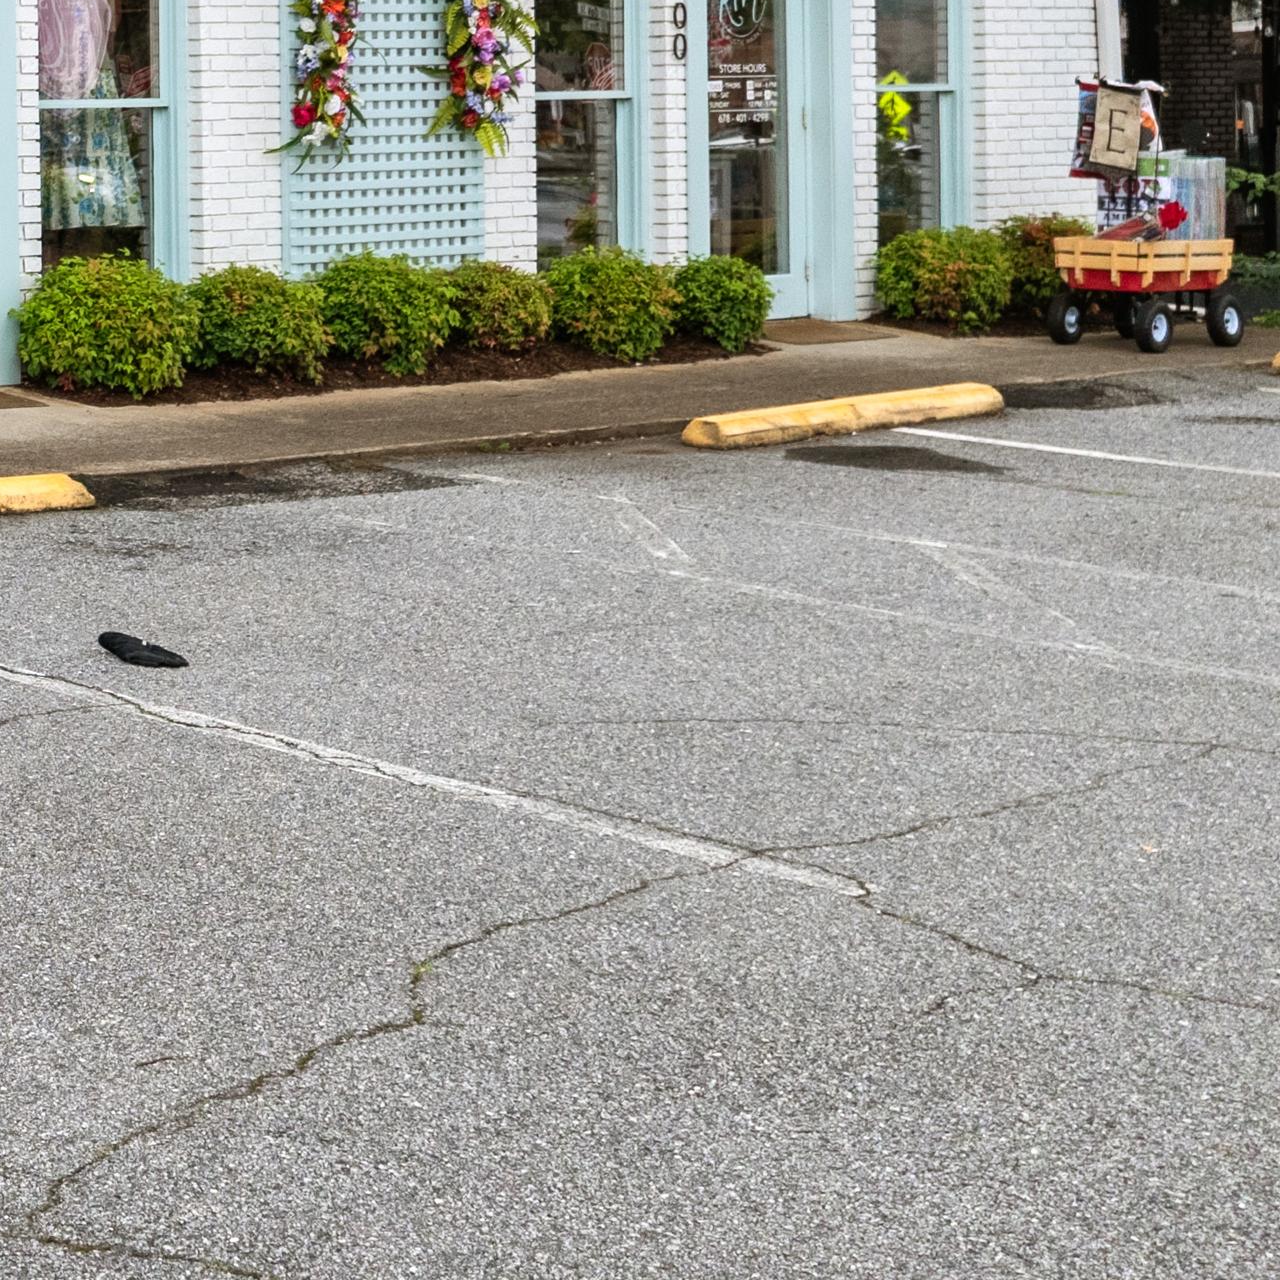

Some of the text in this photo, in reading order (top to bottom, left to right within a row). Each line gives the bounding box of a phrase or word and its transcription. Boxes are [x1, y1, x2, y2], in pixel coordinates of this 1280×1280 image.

[719, 64, 766, 74] STORE HOURS
[1107, 108, 1128, 154] E
